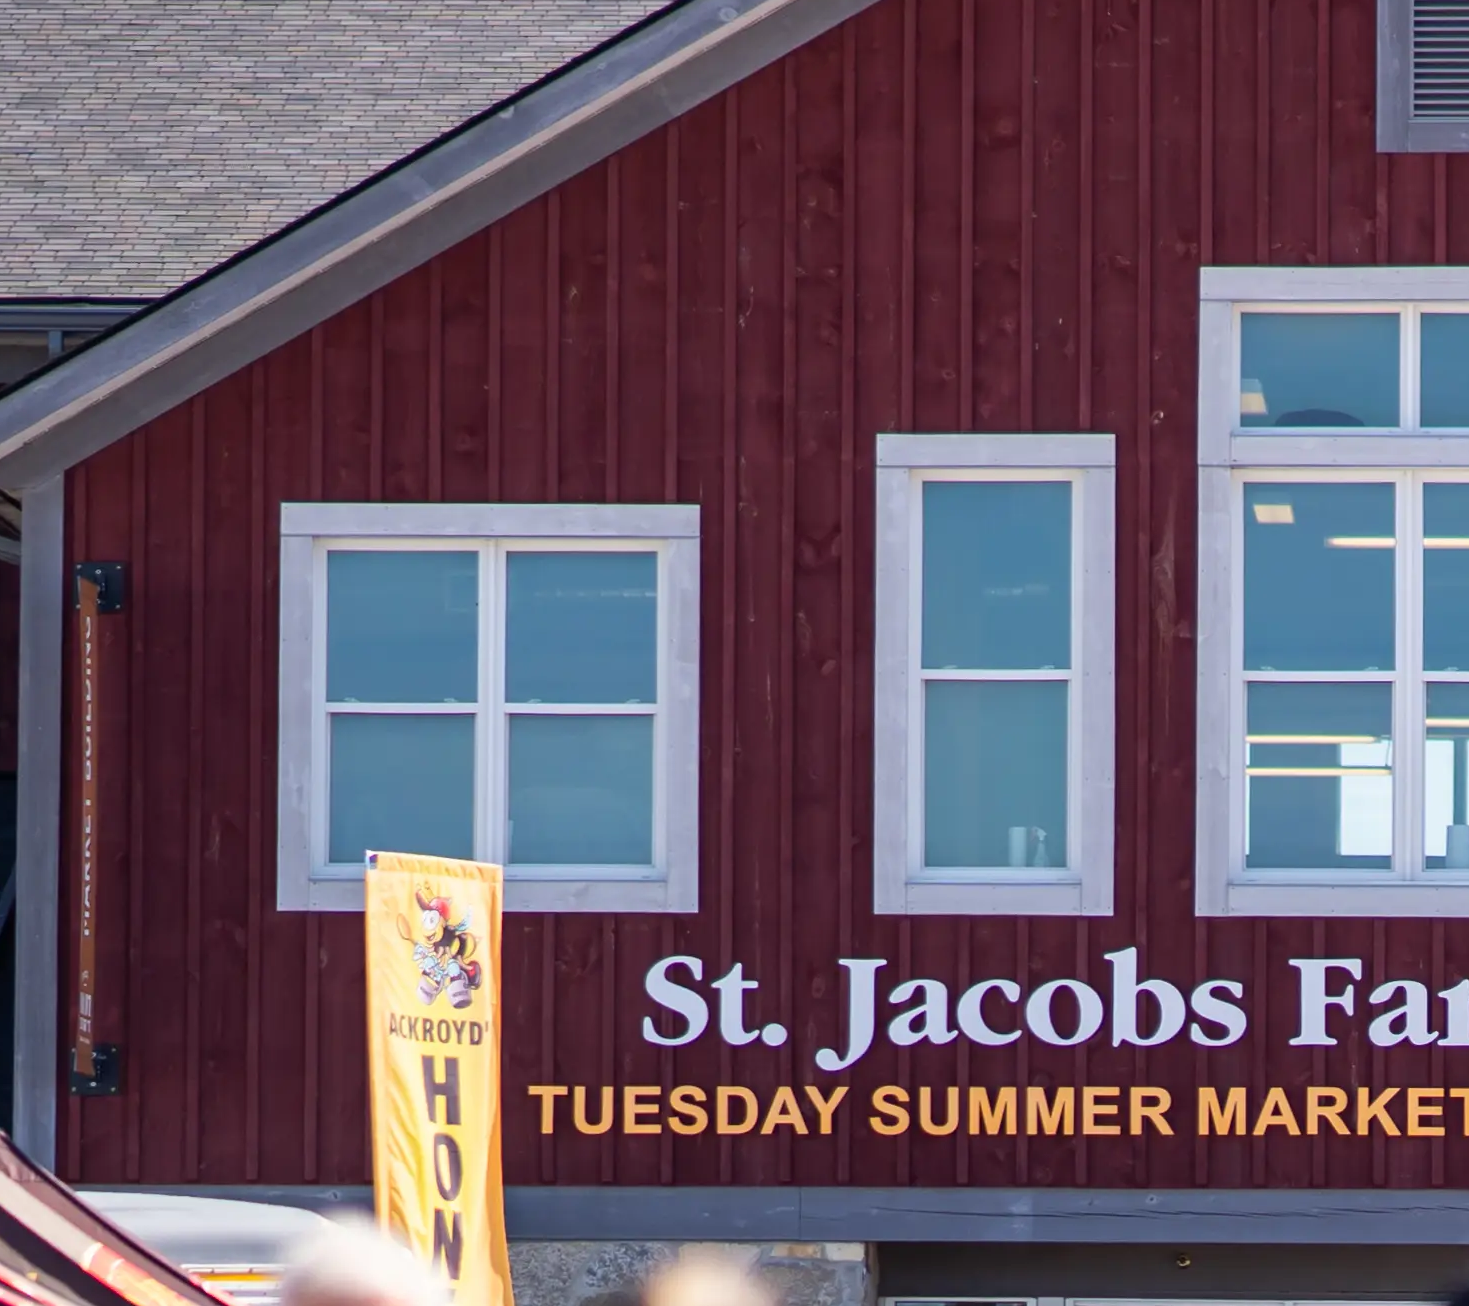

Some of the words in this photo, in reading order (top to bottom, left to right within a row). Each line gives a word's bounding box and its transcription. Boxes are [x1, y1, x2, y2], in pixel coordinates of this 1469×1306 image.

[642, 955, 788, 1047] St.
[815, 946, 1248, 1071] Jacobs
[528, 1085, 849, 1136] TUESDAY
[868, 1085, 1174, 1136] SUMMER
[422, 1055, 463, 1301] HON
